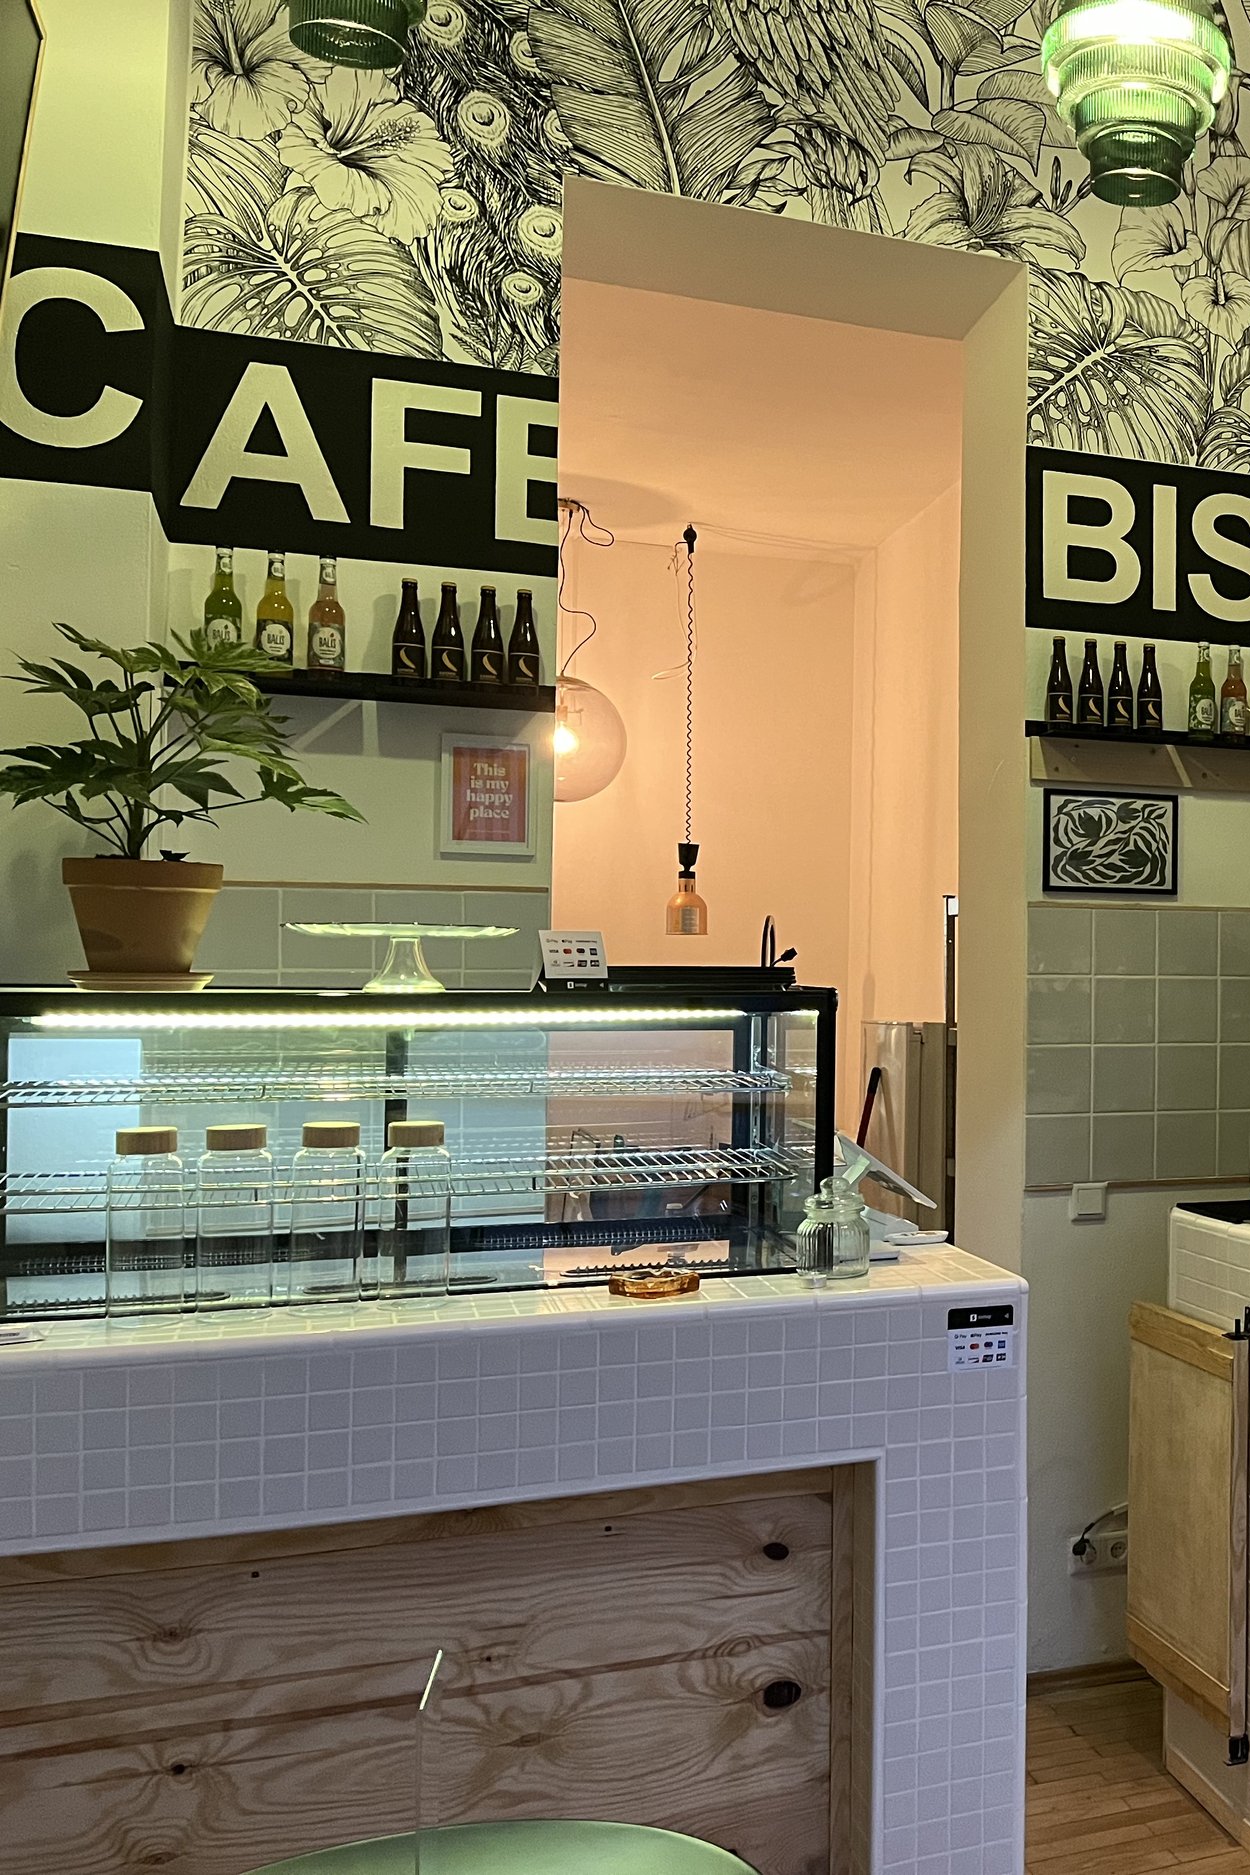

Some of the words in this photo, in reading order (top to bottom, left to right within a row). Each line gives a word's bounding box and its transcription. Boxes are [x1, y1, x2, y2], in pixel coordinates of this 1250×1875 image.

[473, 762, 506, 777] This
[470, 776, 482, 789] is
[486, 780, 509, 793] my
[466, 789, 513, 806] happy
[469, 806, 510, 821] place
